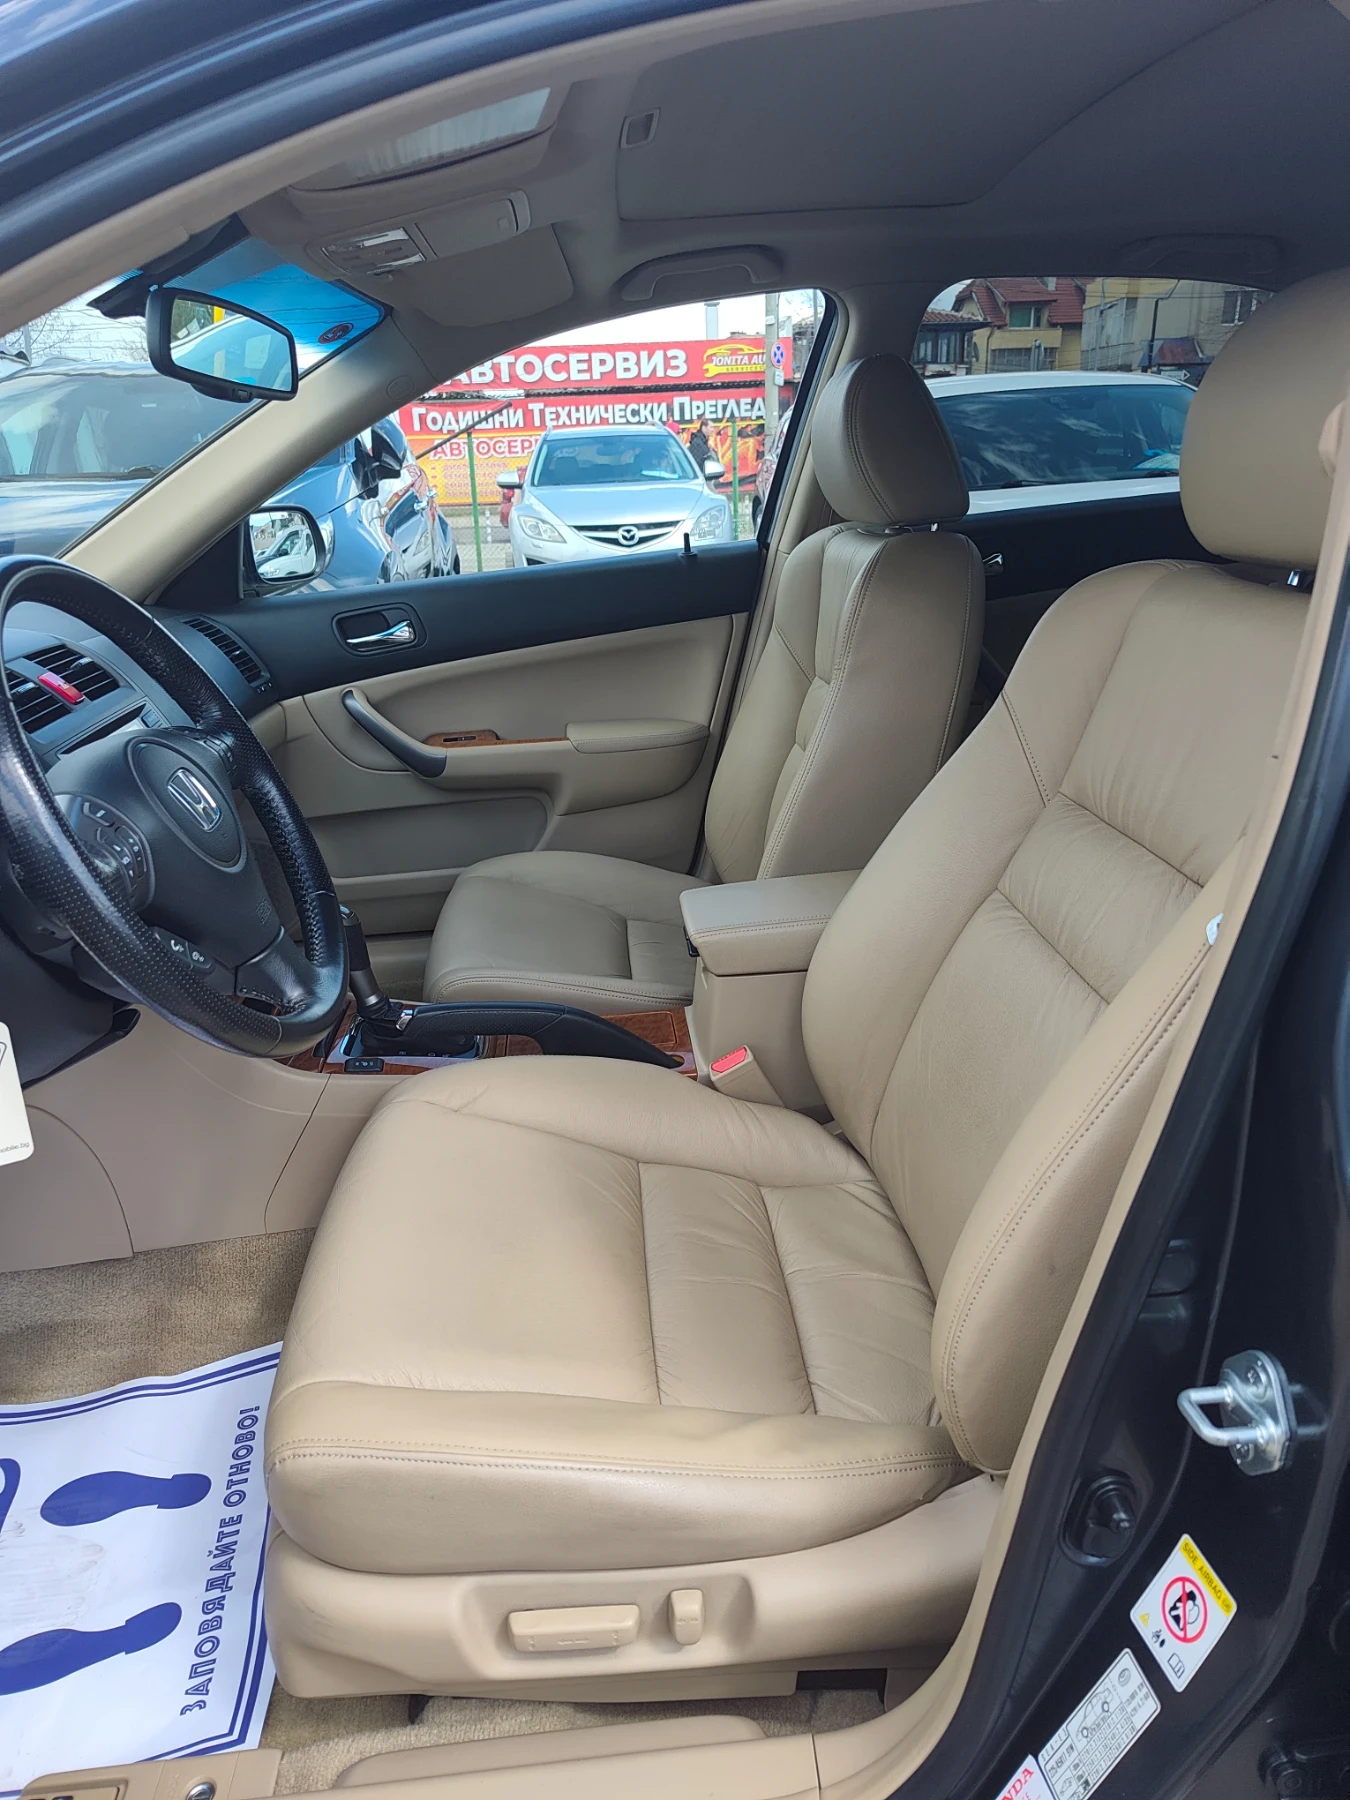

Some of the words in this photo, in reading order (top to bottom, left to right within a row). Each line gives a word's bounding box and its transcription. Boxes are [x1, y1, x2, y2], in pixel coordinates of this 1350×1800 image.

[673, 396, 766, 420] ПРЕГЛЕД
[180, 1513, 242, 1715] ЗАПОВЯДАЙТЕ
[223, 1404, 260, 1508] ОТНОВО!
[1182, 1542, 1198, 1565] SIDE
[1199, 1565, 1222, 1600] AIRBAG
[1001, 1768, 1034, 1800] NDA
